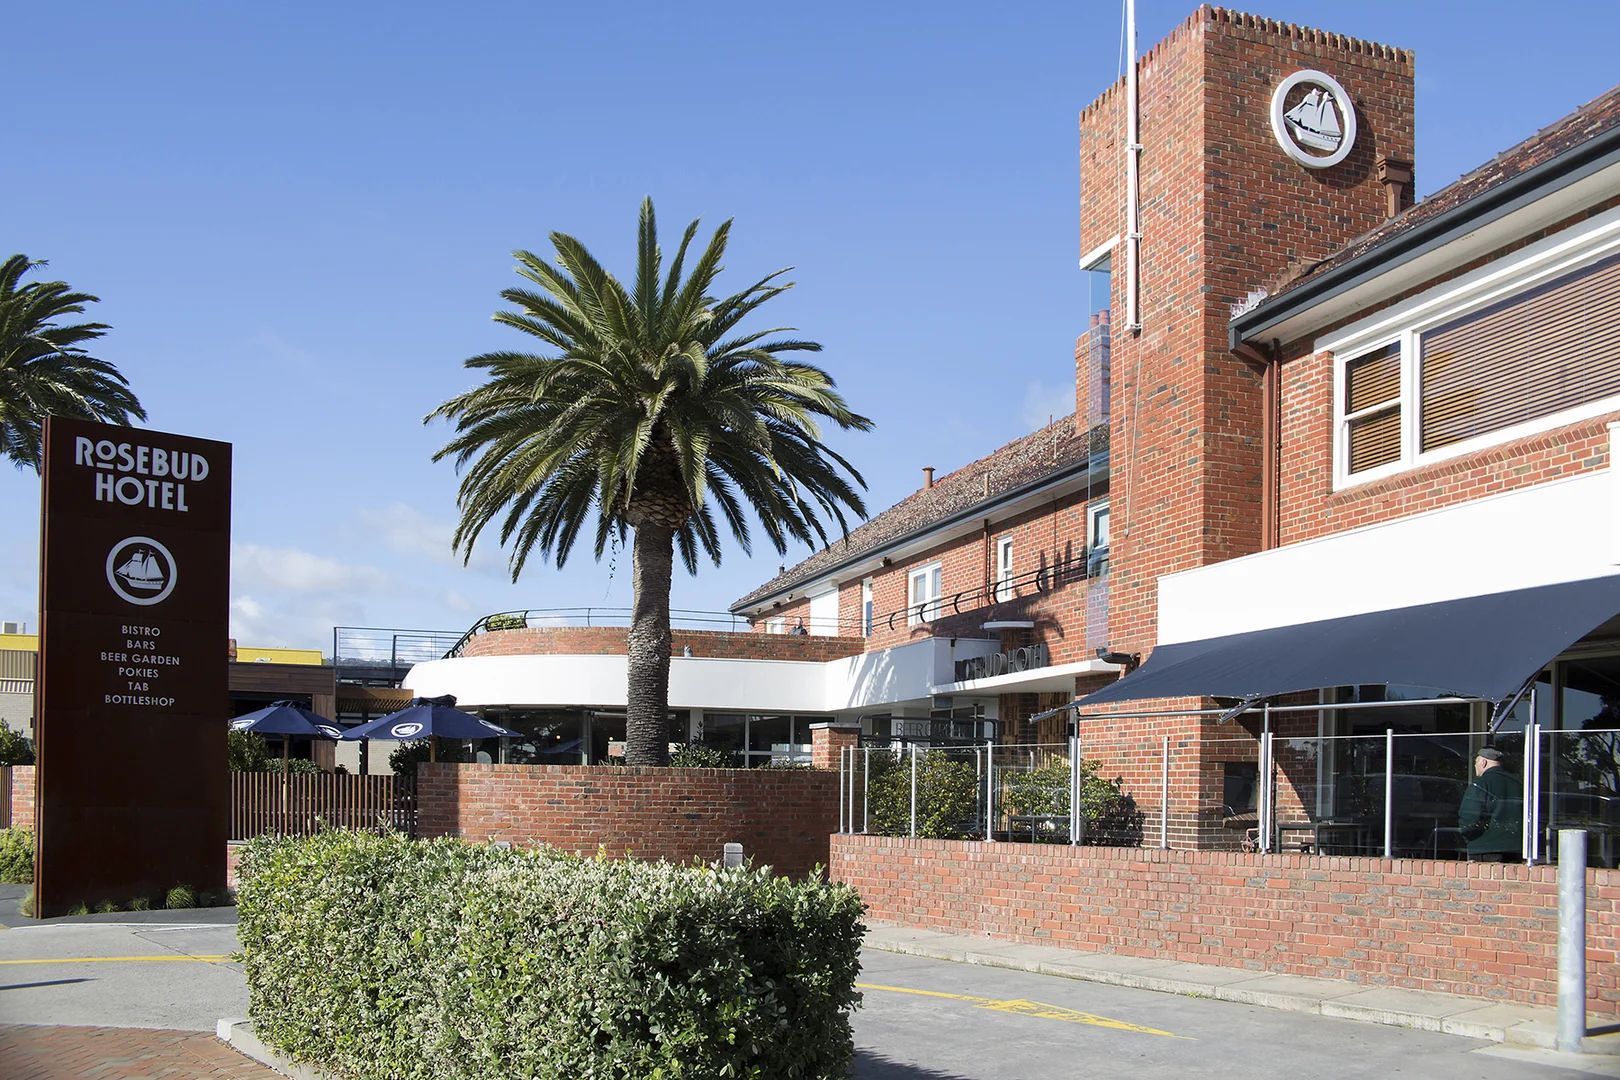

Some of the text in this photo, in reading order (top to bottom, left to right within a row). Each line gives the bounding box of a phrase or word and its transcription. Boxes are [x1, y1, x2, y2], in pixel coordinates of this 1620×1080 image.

[75, 436, 209, 482] ROSEBUD
[95, 472, 189, 512] HOTEL
[122, 625, 161, 636] BISTRO
[127, 640, 155, 650] BARS
[101, 652, 180, 665] BEER GARDEN
[118, 667, 159, 677] POKIES
[128, 682, 149, 691] TAB
[105, 695, 175, 707] BOTTLESHOP
[895, 722, 924, 737] BEER
